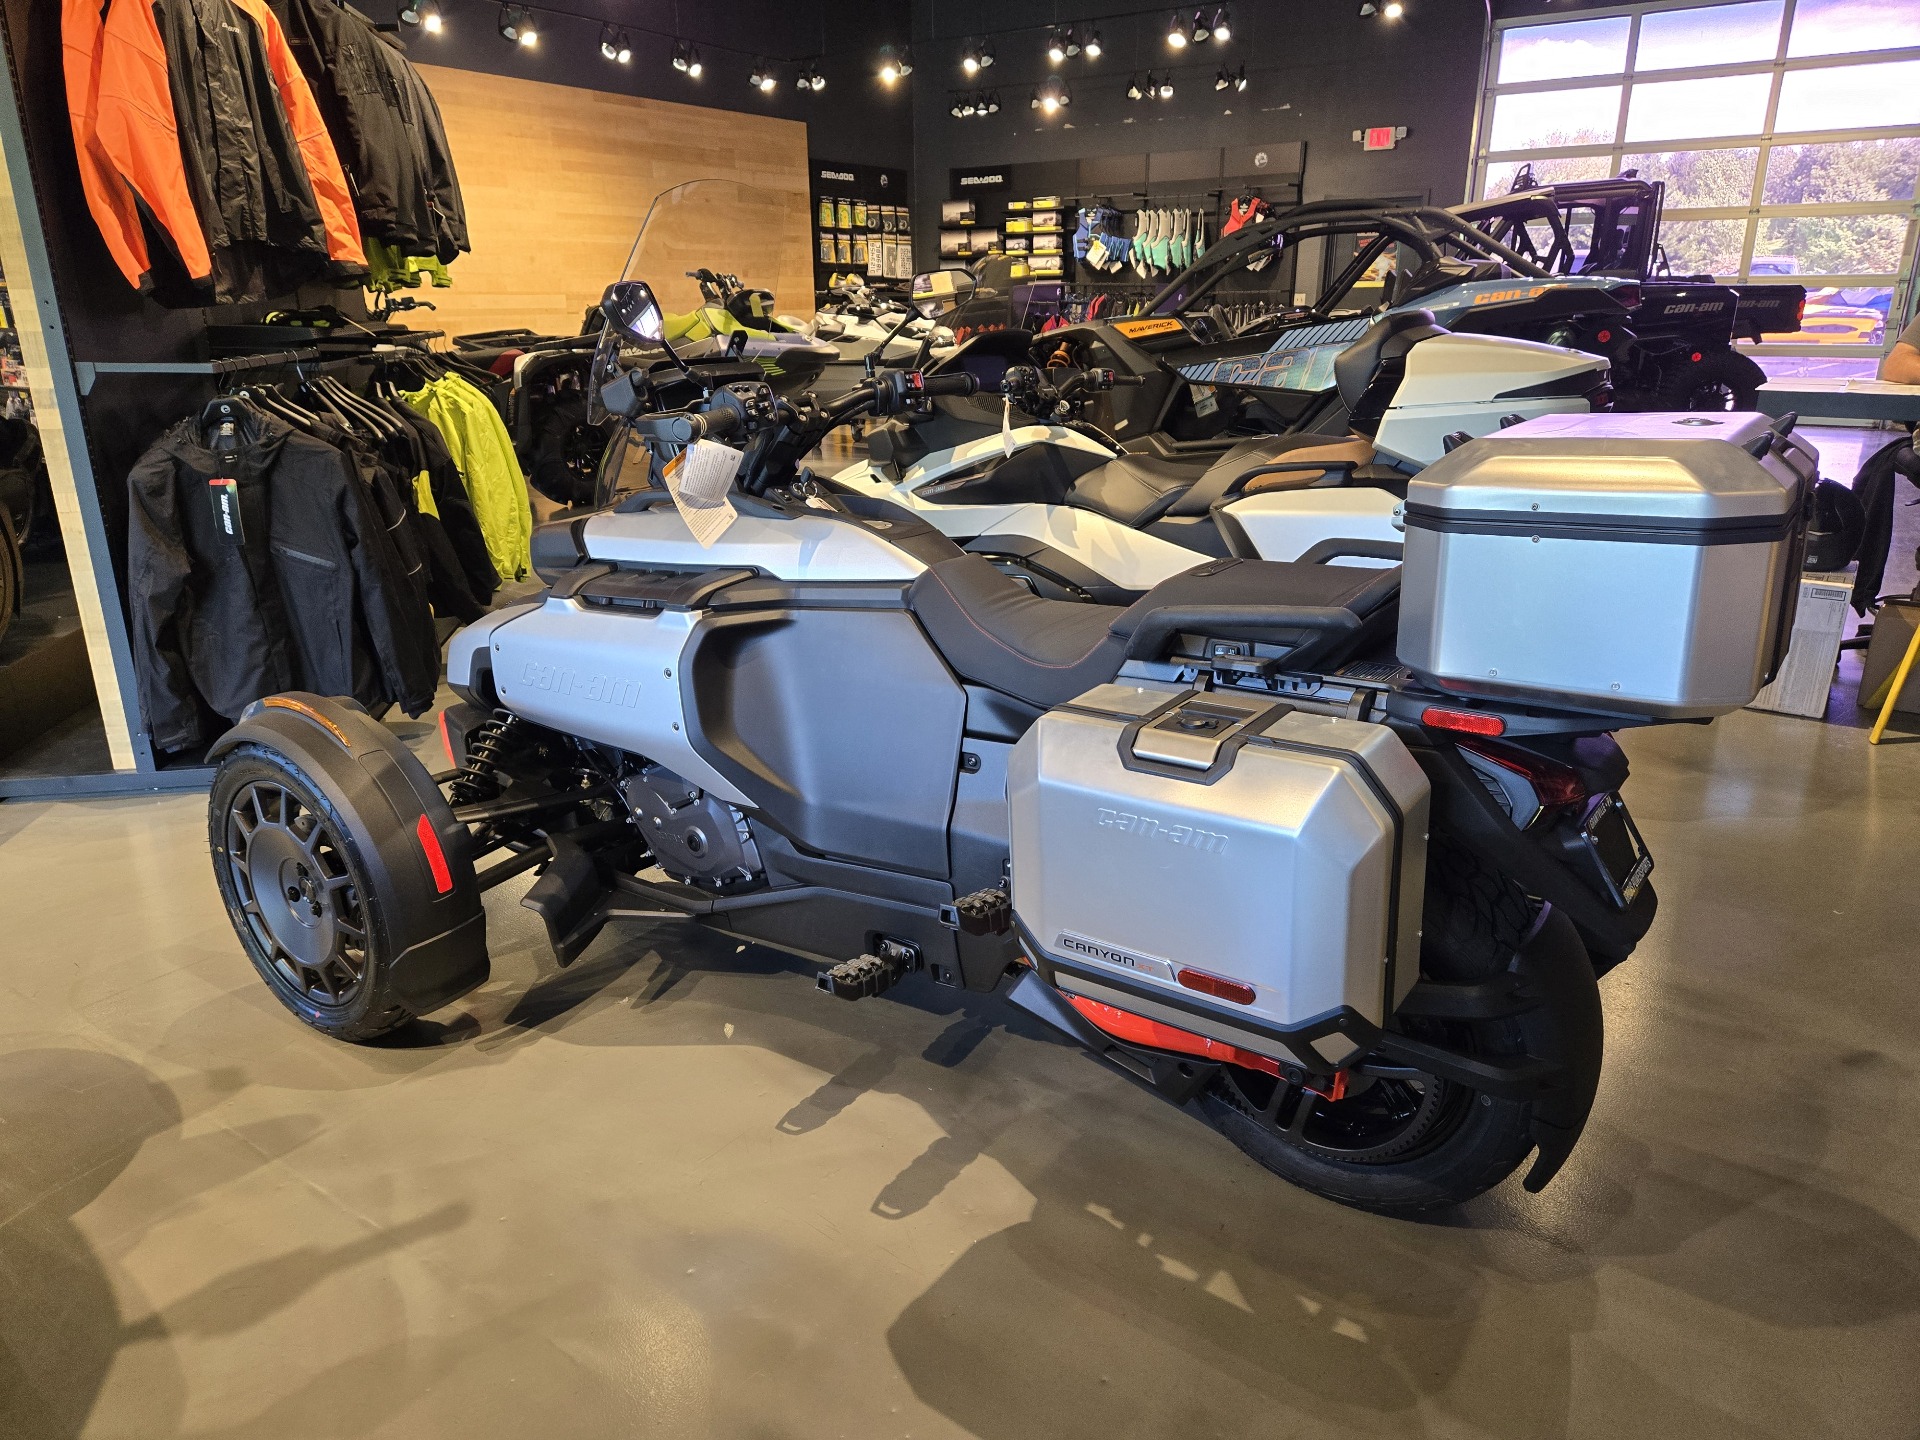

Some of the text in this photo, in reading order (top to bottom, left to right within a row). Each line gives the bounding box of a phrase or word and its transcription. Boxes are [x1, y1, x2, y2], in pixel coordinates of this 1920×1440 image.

[1664, 302, 1724, 315] can-am
[1128, 320, 1174, 334] MAVERICK
[520, 662, 642, 709] can-am
[1097, 807, 1229, 855] can-am
[1063, 938, 1135, 967] CANYON
